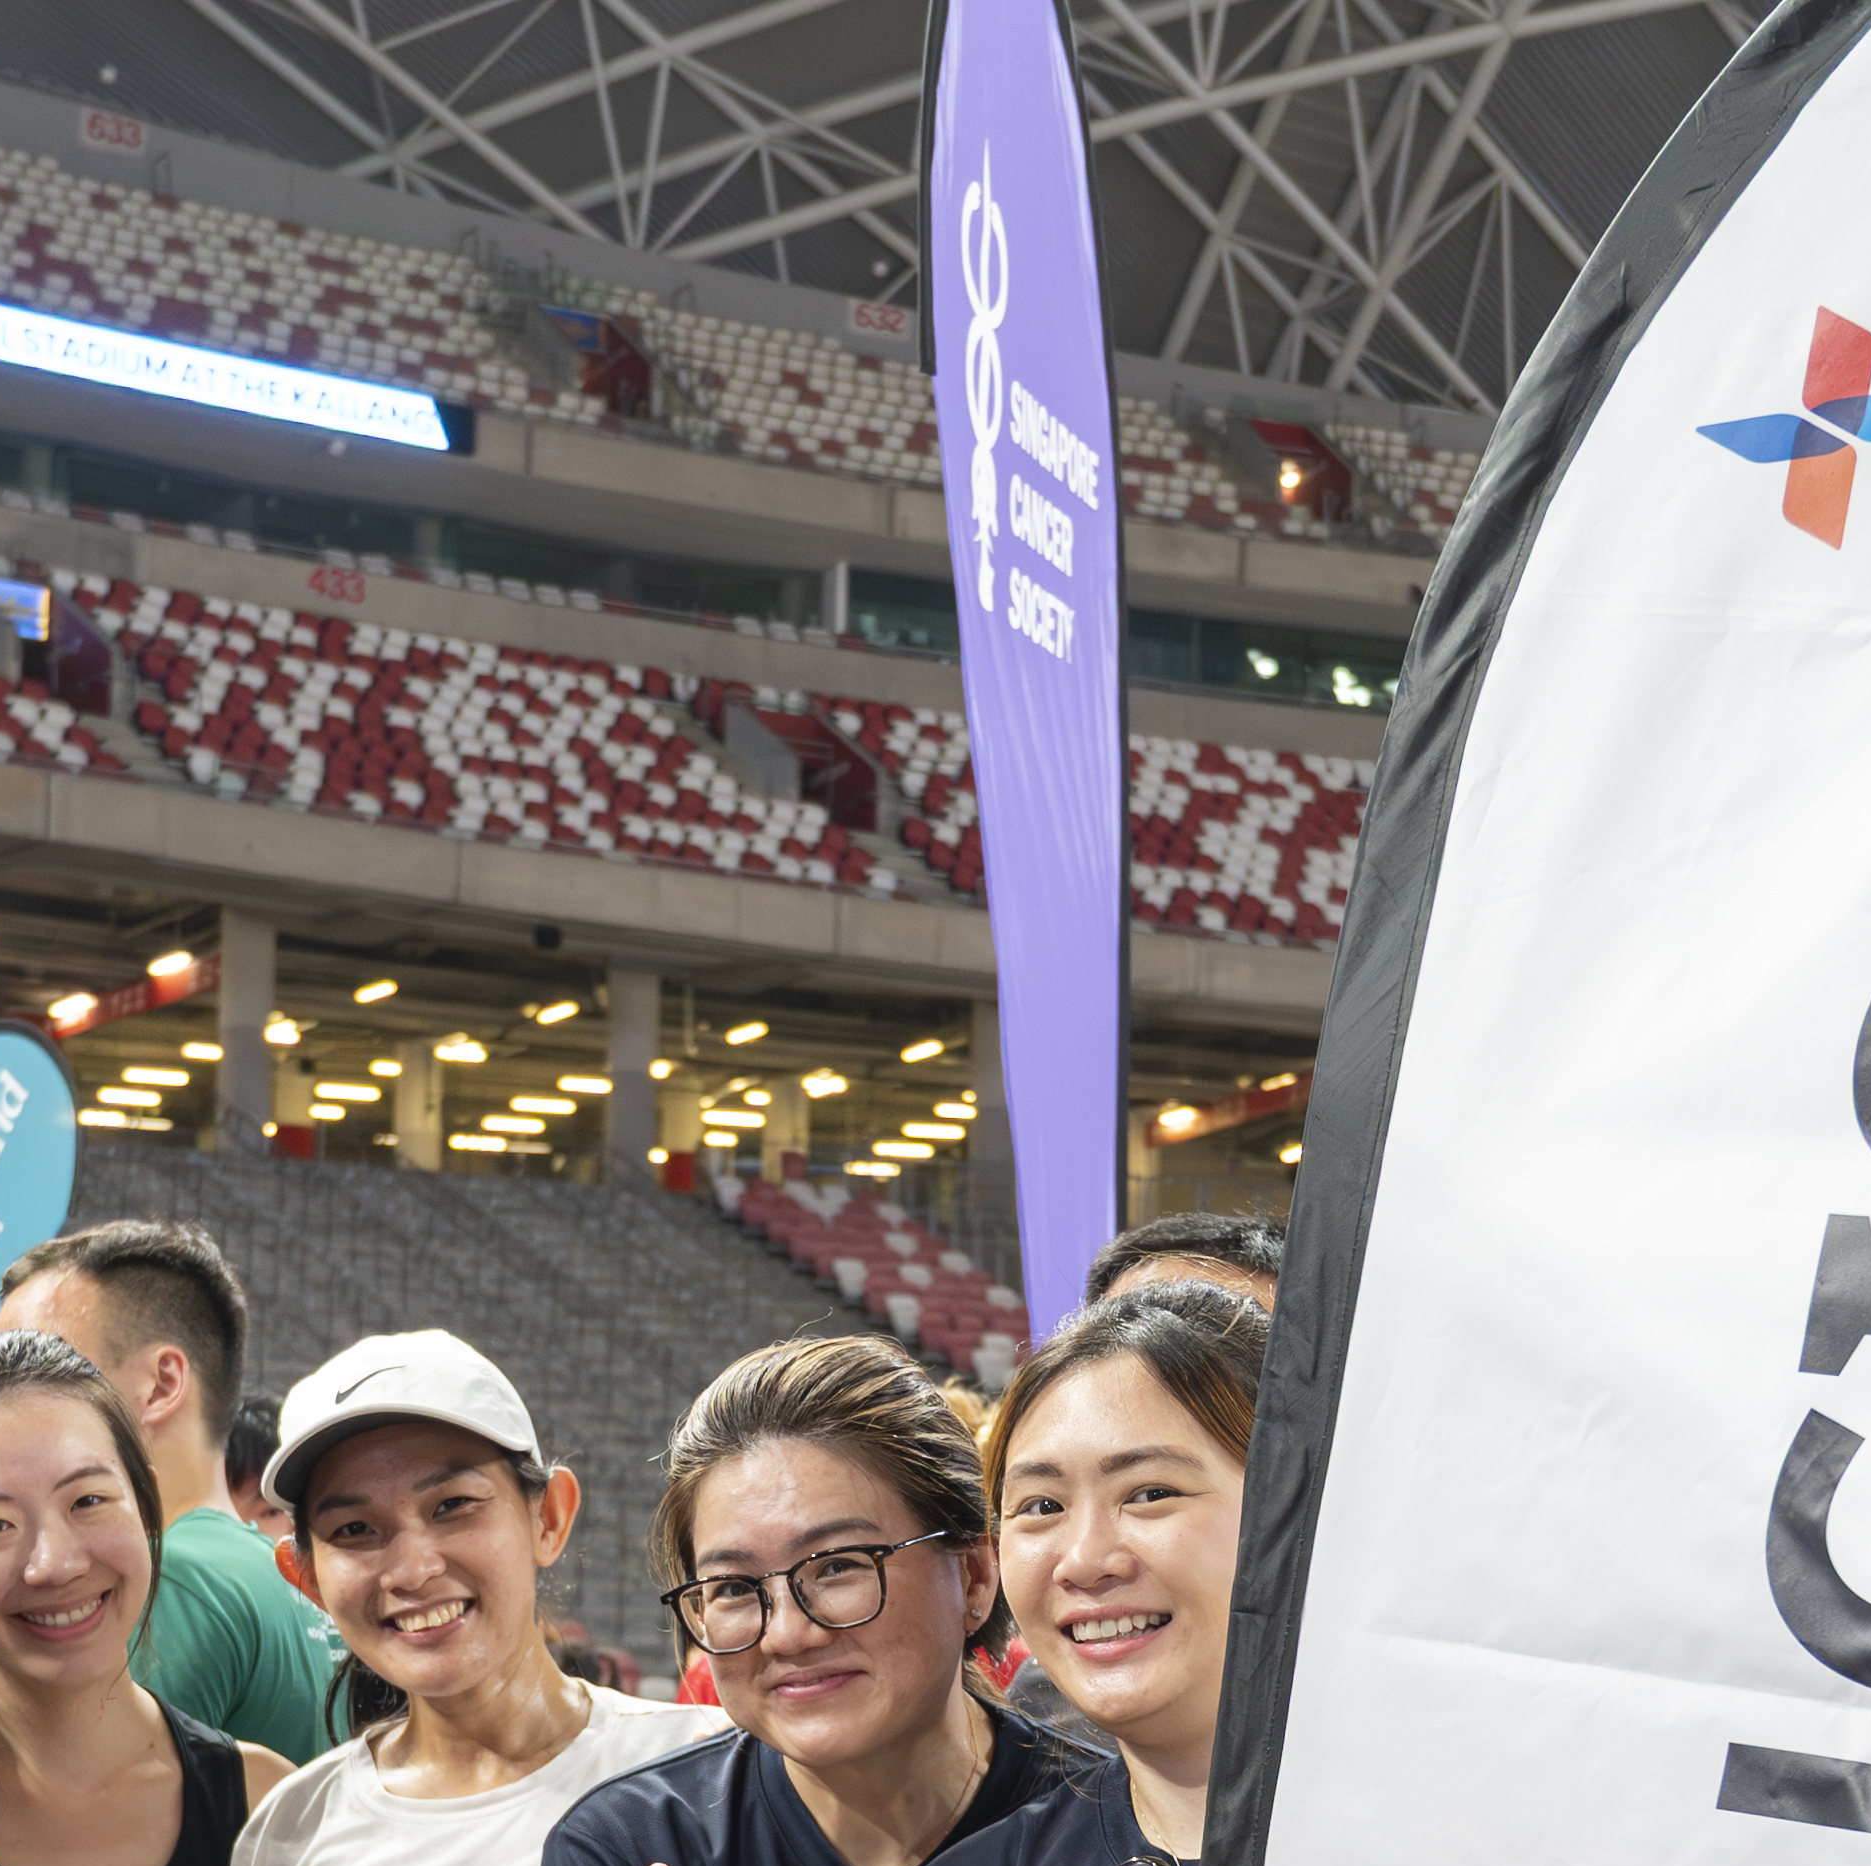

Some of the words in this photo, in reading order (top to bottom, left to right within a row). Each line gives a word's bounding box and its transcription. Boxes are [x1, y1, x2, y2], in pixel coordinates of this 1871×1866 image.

[22, 325, 170, 388] STADIUM
[180, 362, 217, 394] AT
[229, 370, 278, 406] THE
[293, 384, 436, 437] KALLANG
[1009, 380, 1100, 511] SINGAPORE
[1009, 474, 1074, 577] CANCER
[1008, 567, 1075, 665] SOCIETY
